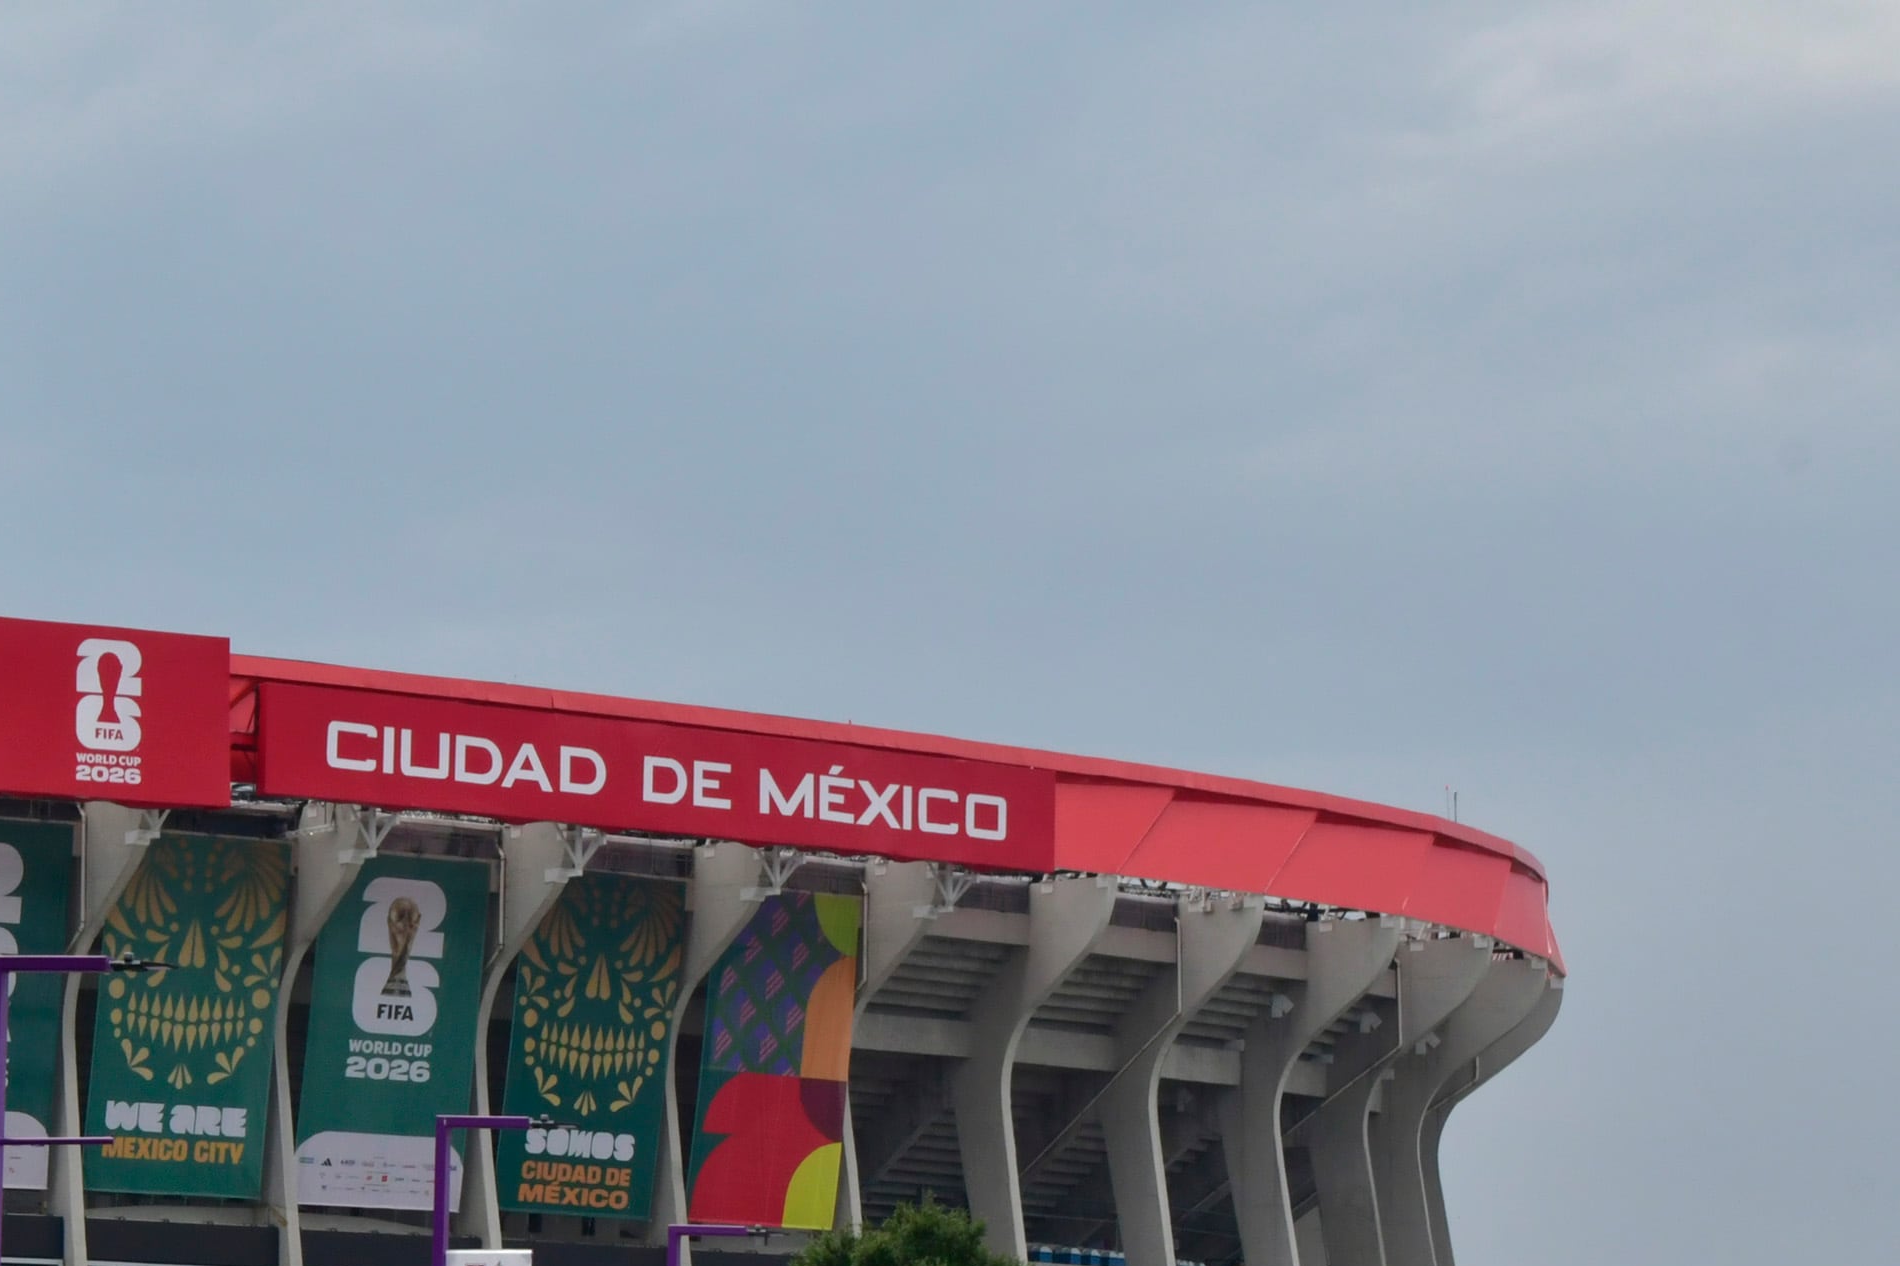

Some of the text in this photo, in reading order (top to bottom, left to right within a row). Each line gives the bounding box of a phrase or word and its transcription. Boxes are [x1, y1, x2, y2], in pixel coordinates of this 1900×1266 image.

[94, 727, 124, 741] FIFA
[76, 752, 142, 767] WORLD CUP
[75, 765, 142, 784] 2026
[326, 719, 1008, 842] CIUDAD DE MÉXICO
[375, 1003, 414, 1022] FIFA
[348, 1038, 433, 1058] WORLD CUP
[345, 1056, 431, 1083] 2026
[104, 1100, 165, 1134] WE
[101, 1136, 245, 1165] MEXICO CITY
[524, 1128, 636, 1162] SOMOS
[521, 1160, 632, 1188] CIUDAD DE
[518, 1181, 630, 1211] MÉXICO
